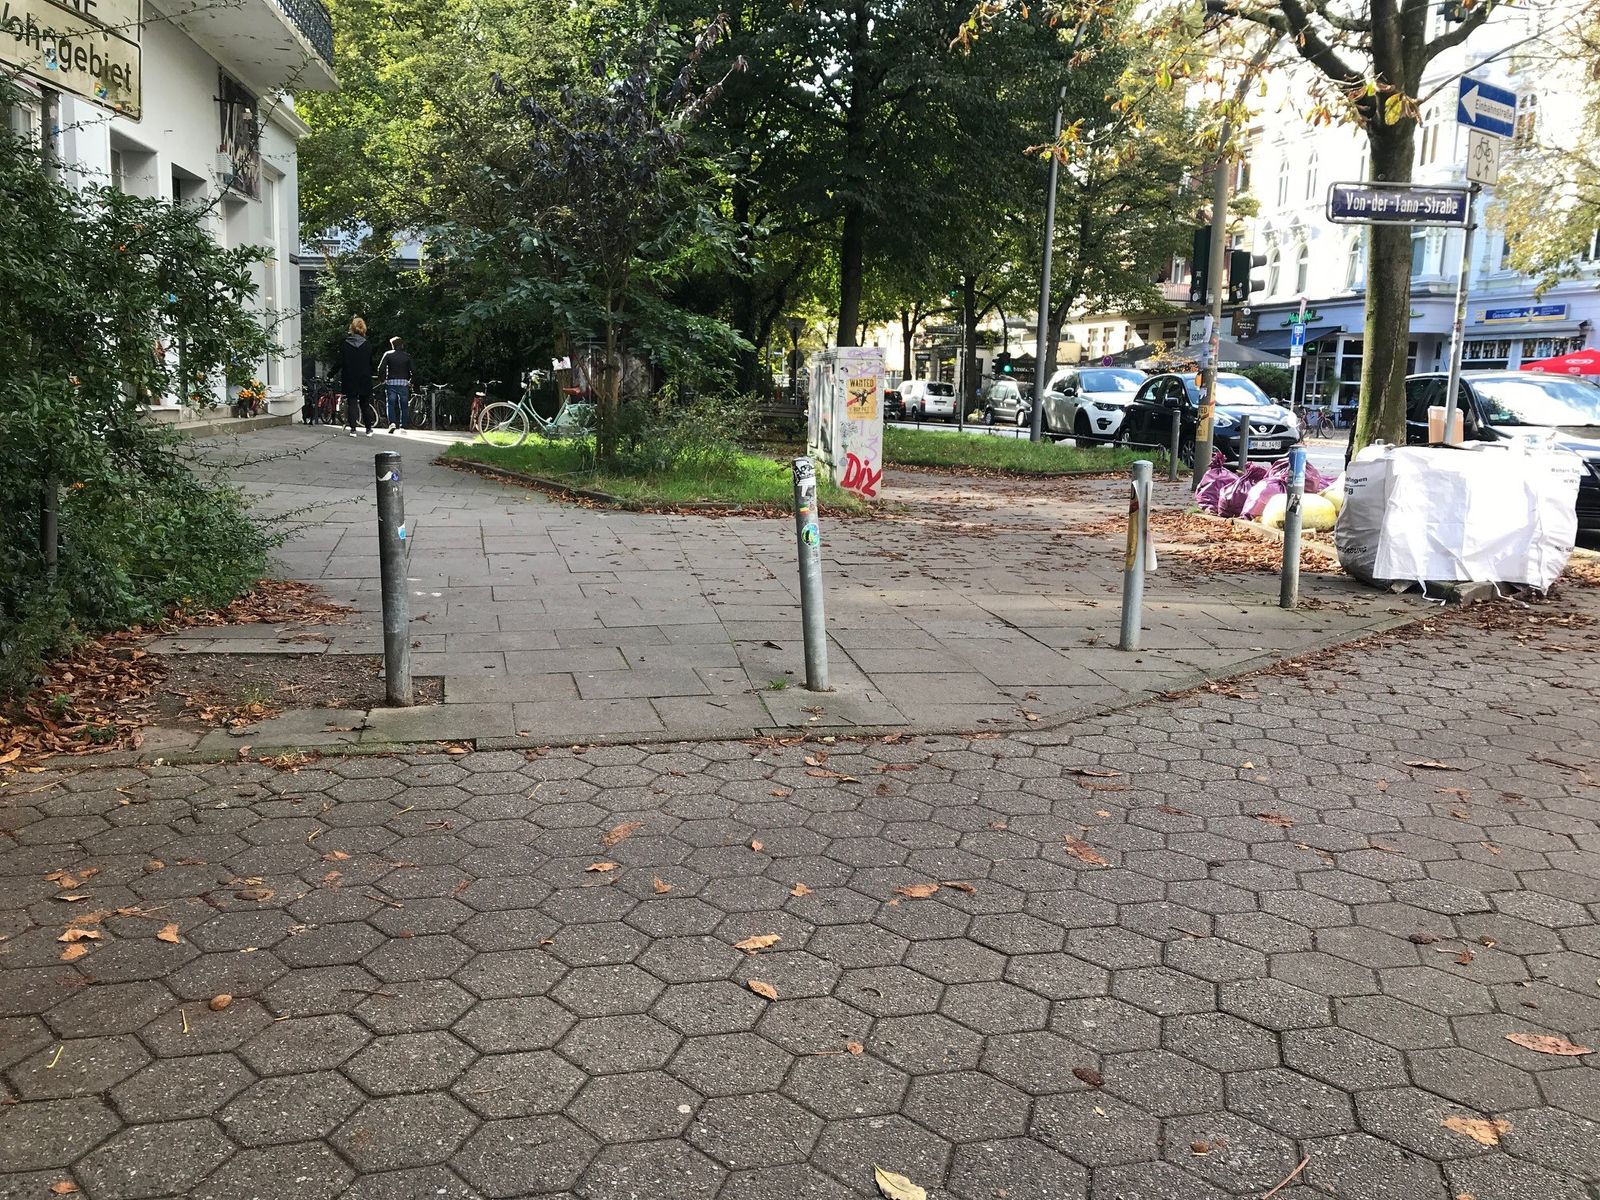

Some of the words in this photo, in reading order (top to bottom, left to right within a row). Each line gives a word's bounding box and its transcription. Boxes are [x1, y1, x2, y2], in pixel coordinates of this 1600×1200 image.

[0, 2, 132, 93] ohngebiet
[1346, 192, 1458, 214] Von-der-Tann-Straße
[850, 379, 874, 387] WANTED
